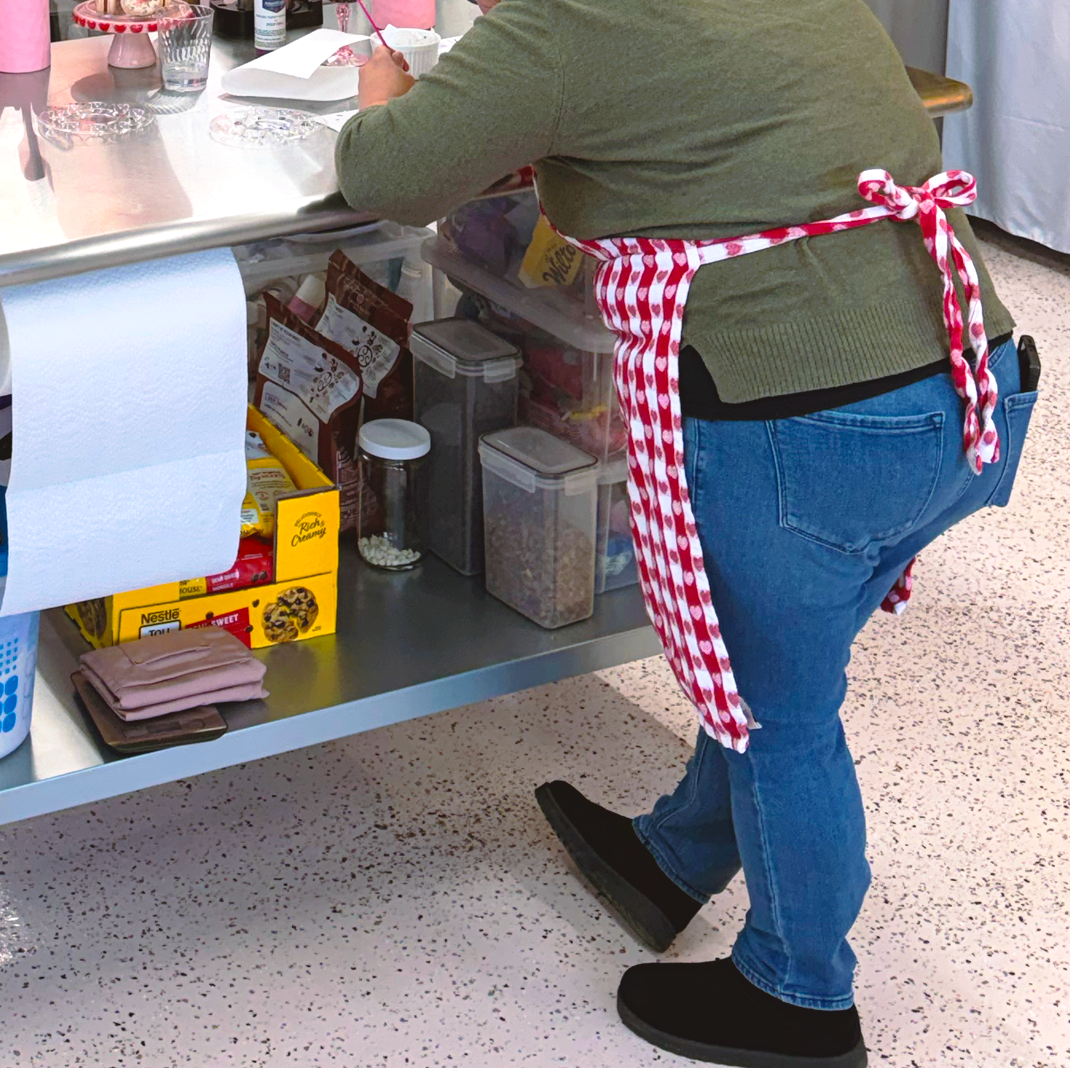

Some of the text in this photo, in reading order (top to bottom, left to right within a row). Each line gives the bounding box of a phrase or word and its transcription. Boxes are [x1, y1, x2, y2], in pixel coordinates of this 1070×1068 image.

[542, 243, 577, 285] Wilto
[299, 518, 321, 535] Rich
[291, 527, 327, 547] Creamy
